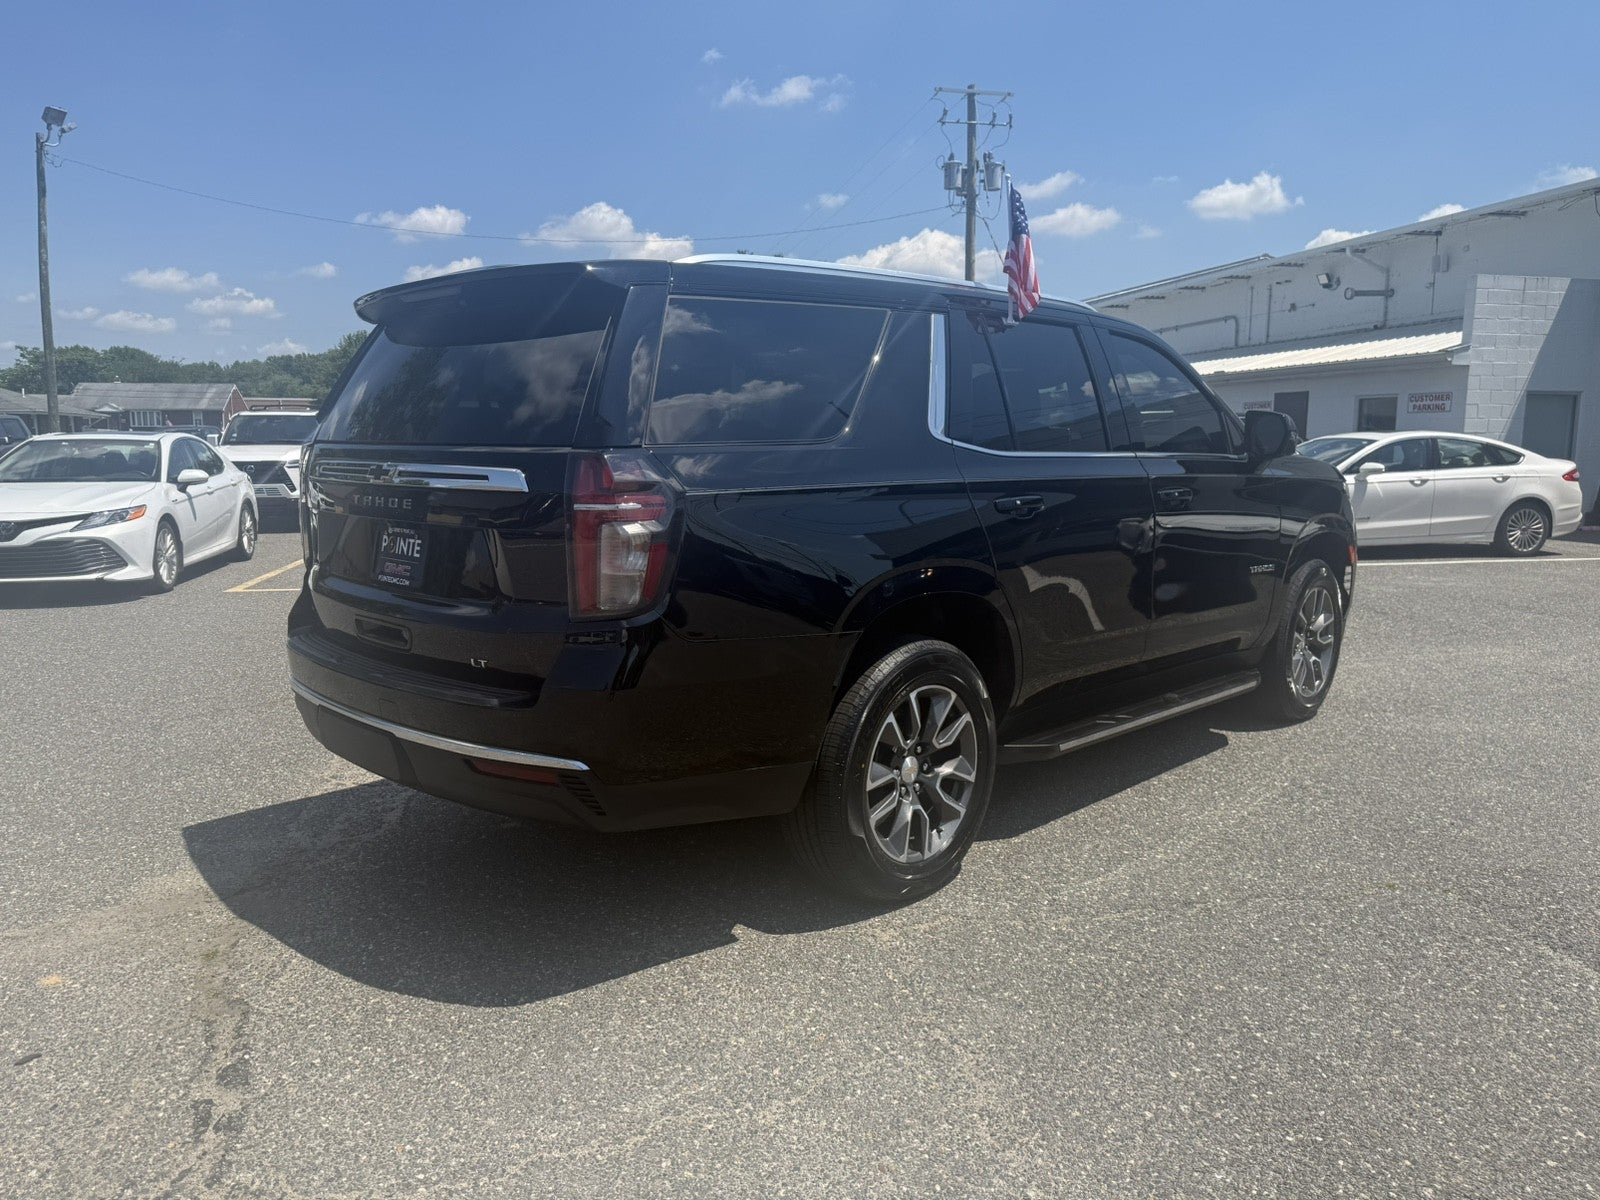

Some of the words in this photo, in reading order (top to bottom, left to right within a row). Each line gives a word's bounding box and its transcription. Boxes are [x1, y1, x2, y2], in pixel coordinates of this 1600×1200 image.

[1409, 393, 1451, 403] CUSTOMER
[1412, 402, 1446, 412] PARKING
[352, 494, 413, 510] TAHOE
[381, 534, 422, 558] POINTE
[470, 657, 488, 669] LT
